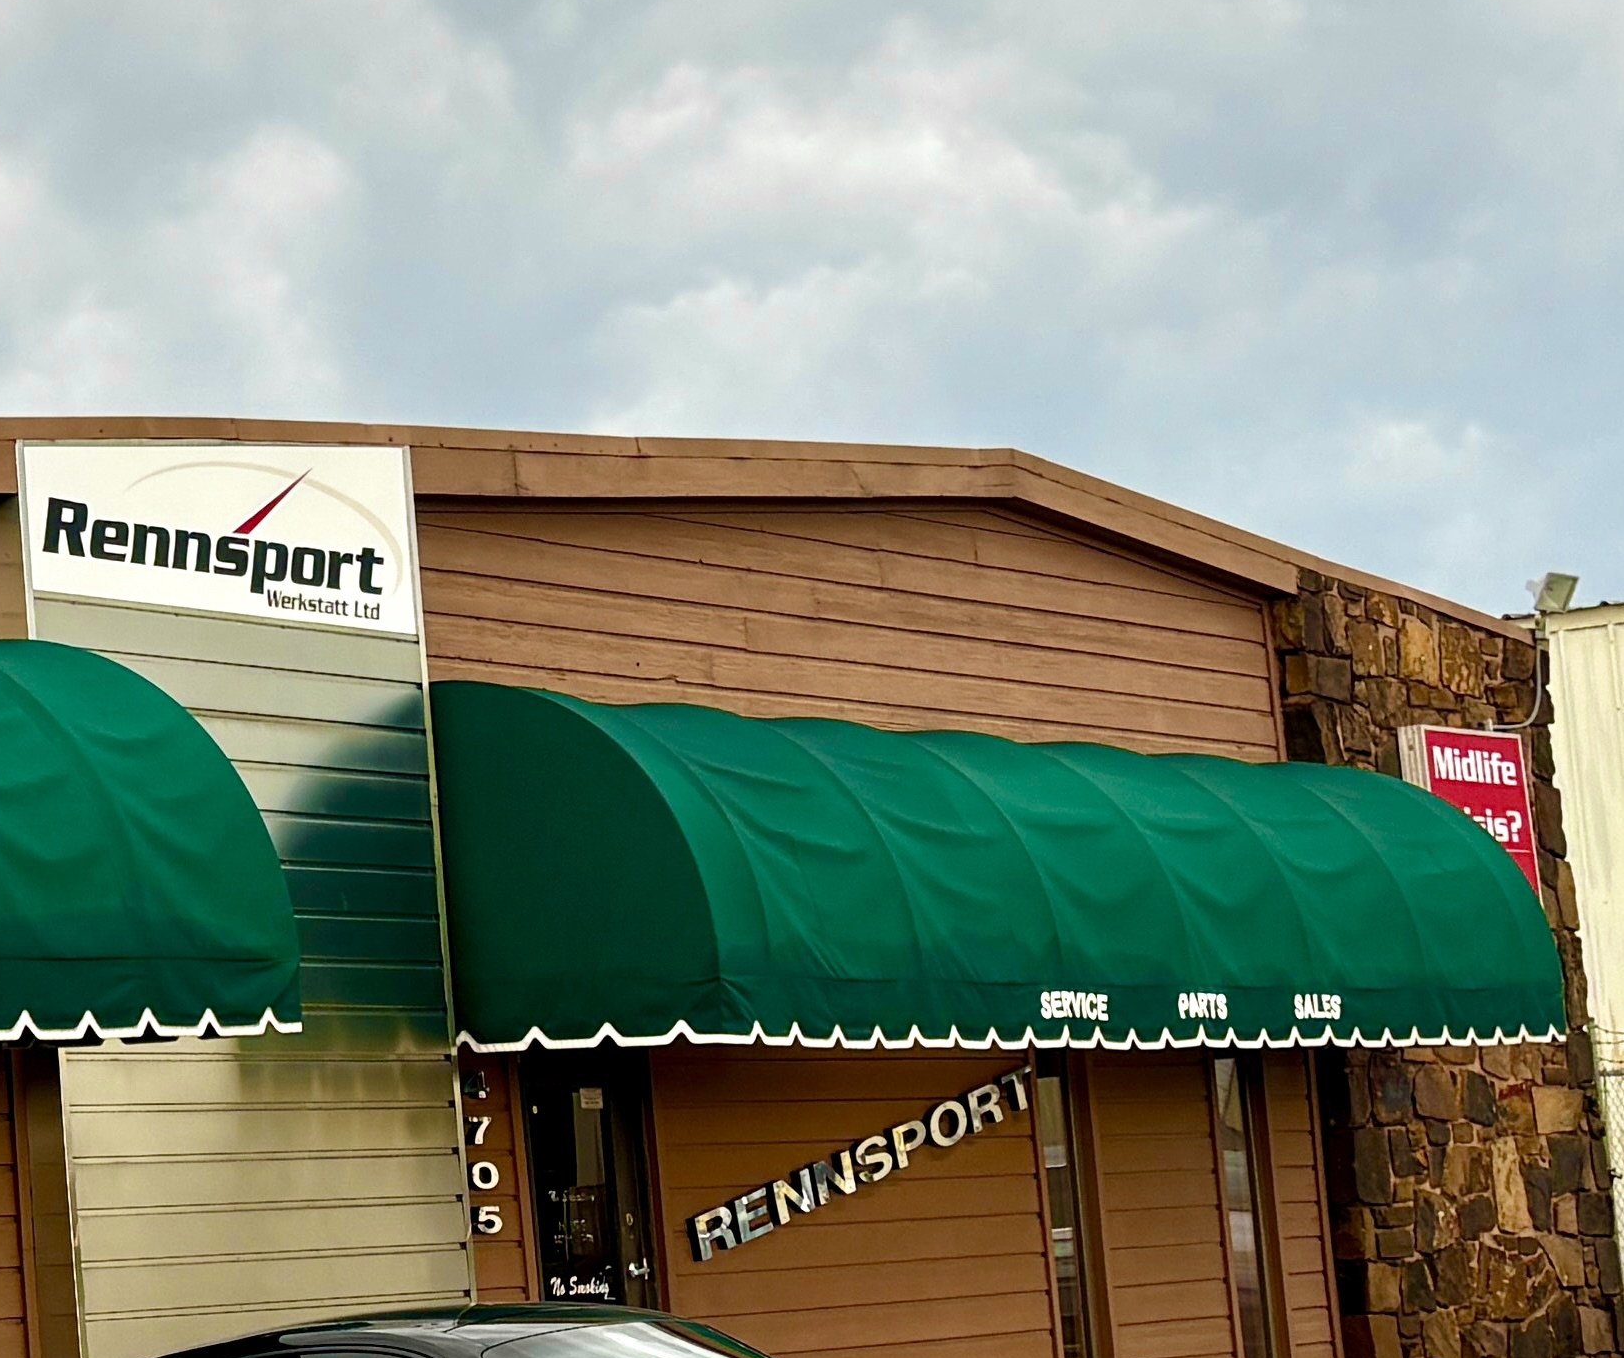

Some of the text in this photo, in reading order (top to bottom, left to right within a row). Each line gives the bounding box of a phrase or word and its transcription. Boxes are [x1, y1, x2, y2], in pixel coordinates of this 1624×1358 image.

[42, 497, 384, 595] Rennsport
[266, 589, 380, 621] Werkstatt Ltd
[1432, 745, 1518, 786] Midlife
[1463, 806, 1522, 843] is?
[1040, 990, 1342, 1022] SERVICE PARTS SALES
[690, 1065, 1032, 1262] RENNSPORT
